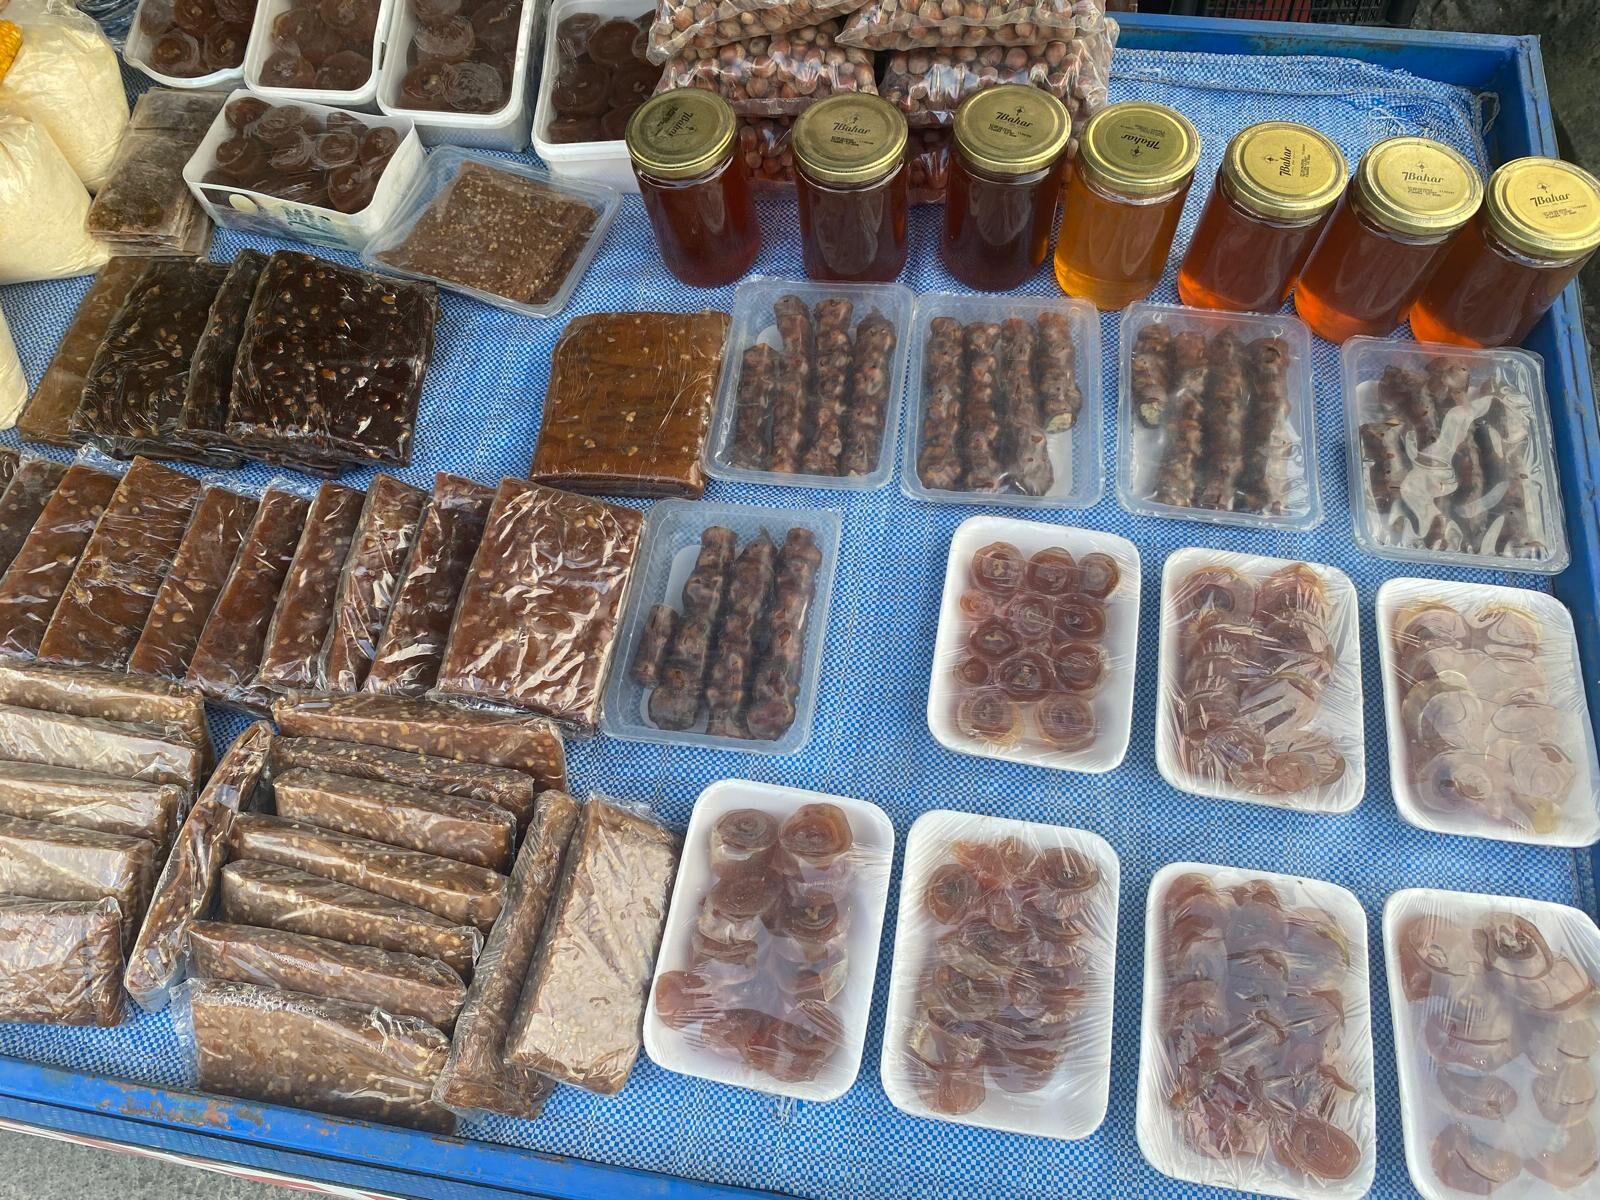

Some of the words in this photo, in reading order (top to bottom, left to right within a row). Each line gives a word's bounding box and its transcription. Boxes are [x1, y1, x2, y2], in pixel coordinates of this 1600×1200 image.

[995, 111, 1033, 127] 7Bahar
[833, 122, 871, 134] 7Bahar
[1121, 134, 1160, 150] 7Bahar
[1280, 146, 1292, 176] 7Bahar
[1402, 171, 1444, 183] 7Bahar
[1530, 192, 1570, 207] 7Bahar
